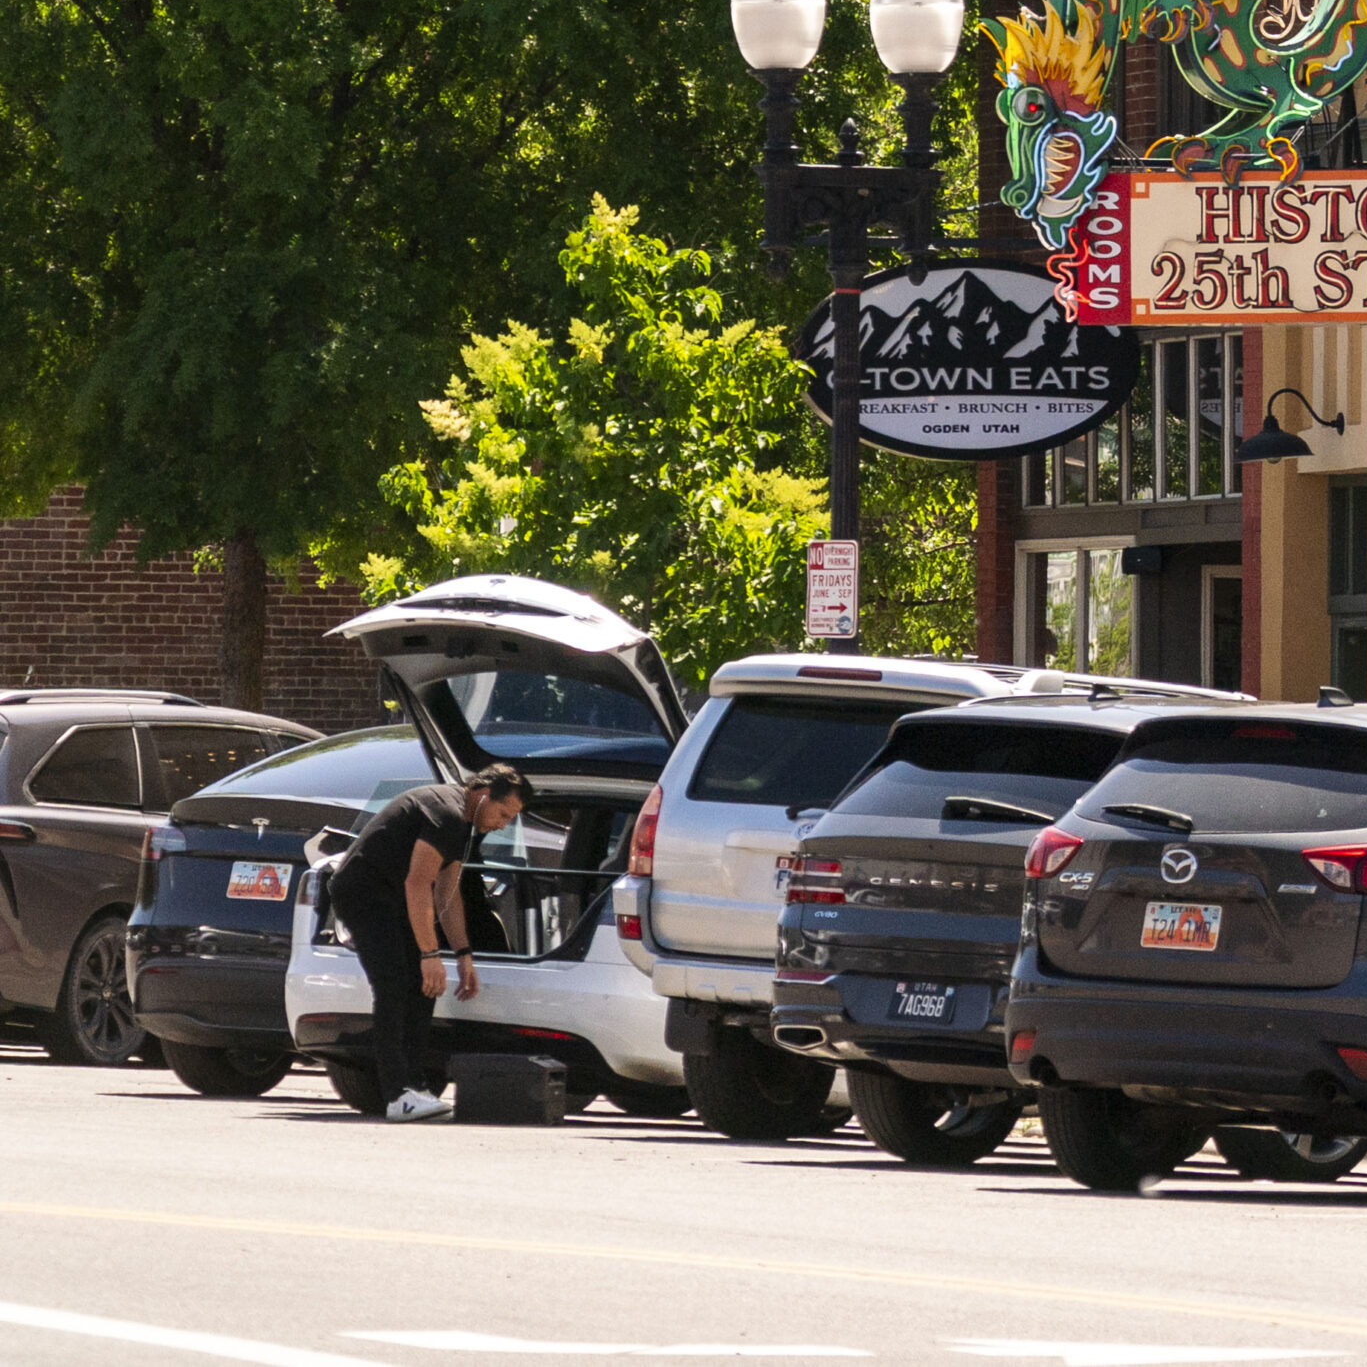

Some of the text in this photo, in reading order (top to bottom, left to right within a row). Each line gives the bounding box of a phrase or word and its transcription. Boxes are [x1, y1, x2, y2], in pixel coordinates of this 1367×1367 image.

[1087, 191, 1123, 309] ROOMS
[1151, 247, 1294, 309] 25th
[1010, 366, 1110, 391] EATS
[859, 402, 1094, 414] REAKFAST BRUNCH BITES
[922, 424, 1020, 434] OGDEN UTAH
[810, 547, 824, 566] NO
[812, 574, 852, 587] FRIDAYS
[812, 589, 830, 598] JUNE
[838, 589, 852, 599] SEP
[869, 876, 998, 892] GENESIS
[1059, 872, 1095, 883] CX-5
[1151, 918, 1176, 941] T24
[897, 993, 946, 1018] 7AG968
